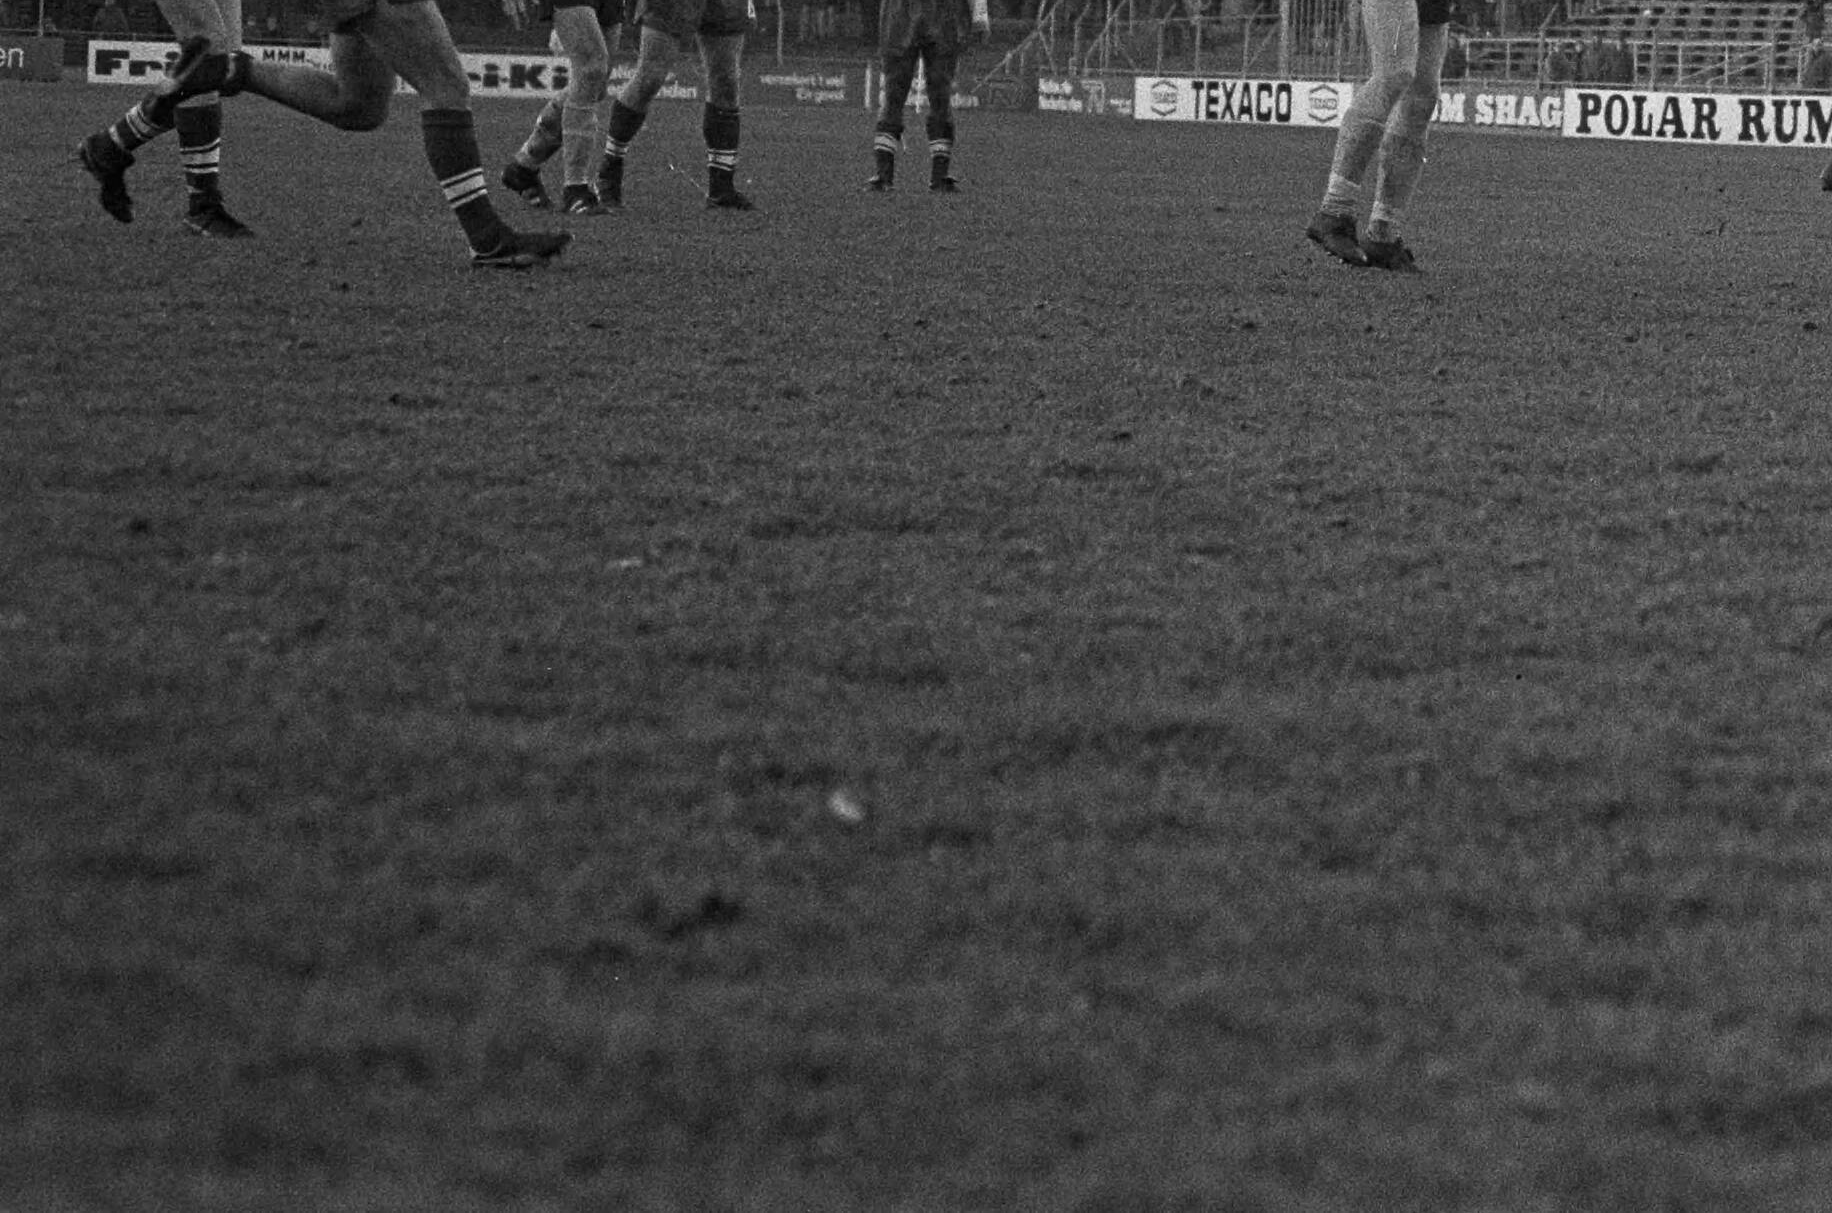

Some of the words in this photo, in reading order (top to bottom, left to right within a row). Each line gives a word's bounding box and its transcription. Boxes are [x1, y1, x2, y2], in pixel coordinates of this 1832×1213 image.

[1191, 81, 1292, 123] TEXACO
[1475, 95, 1564, 129] SHAG
[1576, 94, 1722, 141] POLAR
